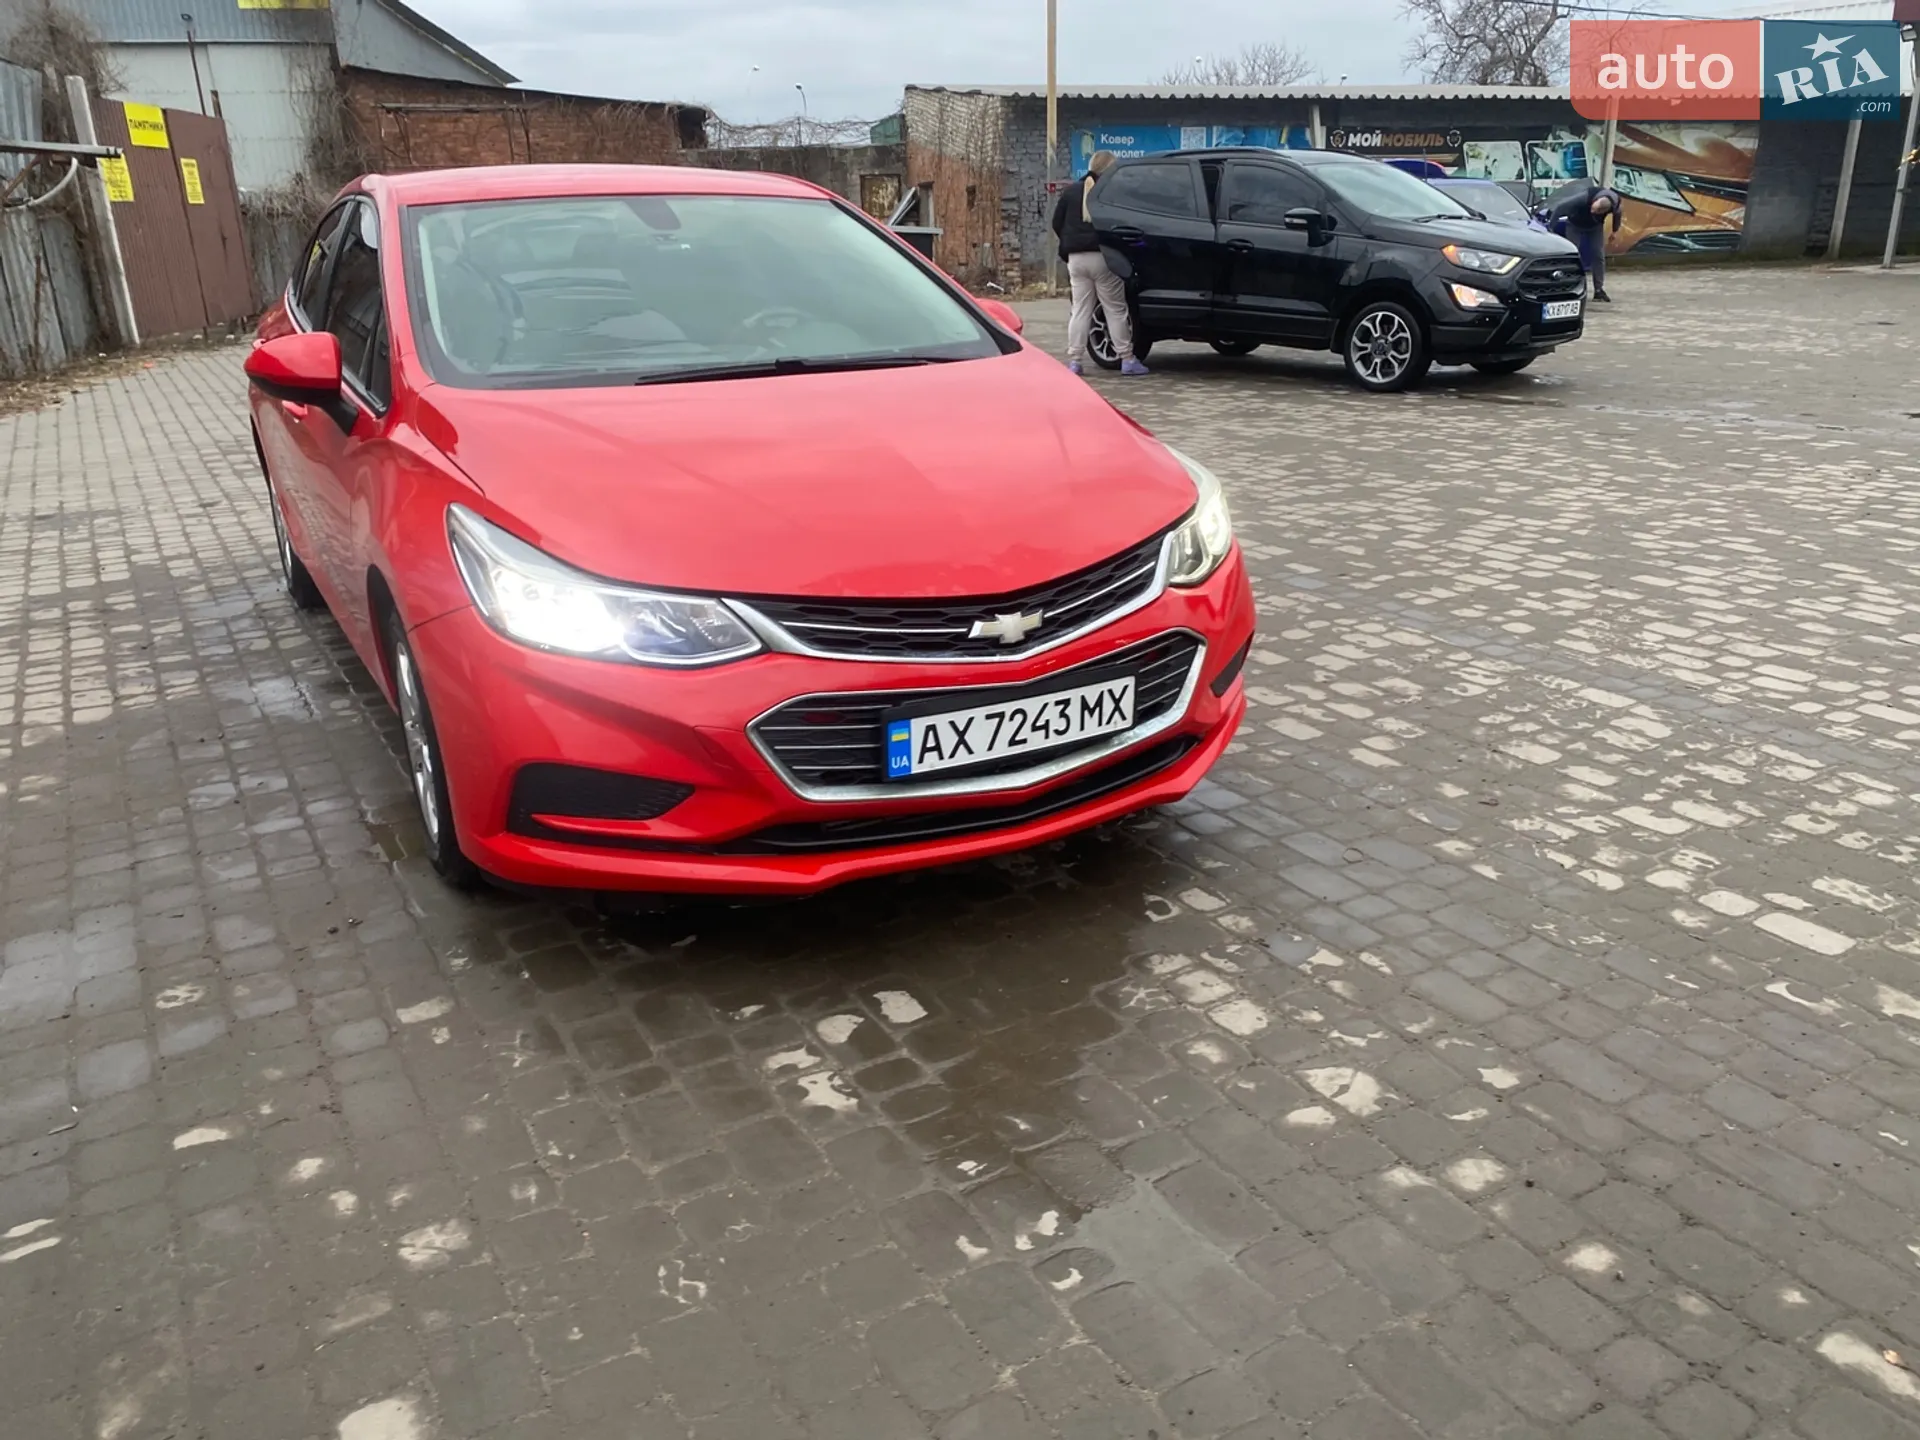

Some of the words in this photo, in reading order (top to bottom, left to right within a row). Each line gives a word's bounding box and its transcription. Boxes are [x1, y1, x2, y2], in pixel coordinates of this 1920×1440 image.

[1101, 133, 1135, 146] Ковер
[917, 716, 975, 764] AX
[985, 697, 1072, 752] 7243
[1079, 684, 1130, 732] MX
[891, 755, 910, 769] UA
